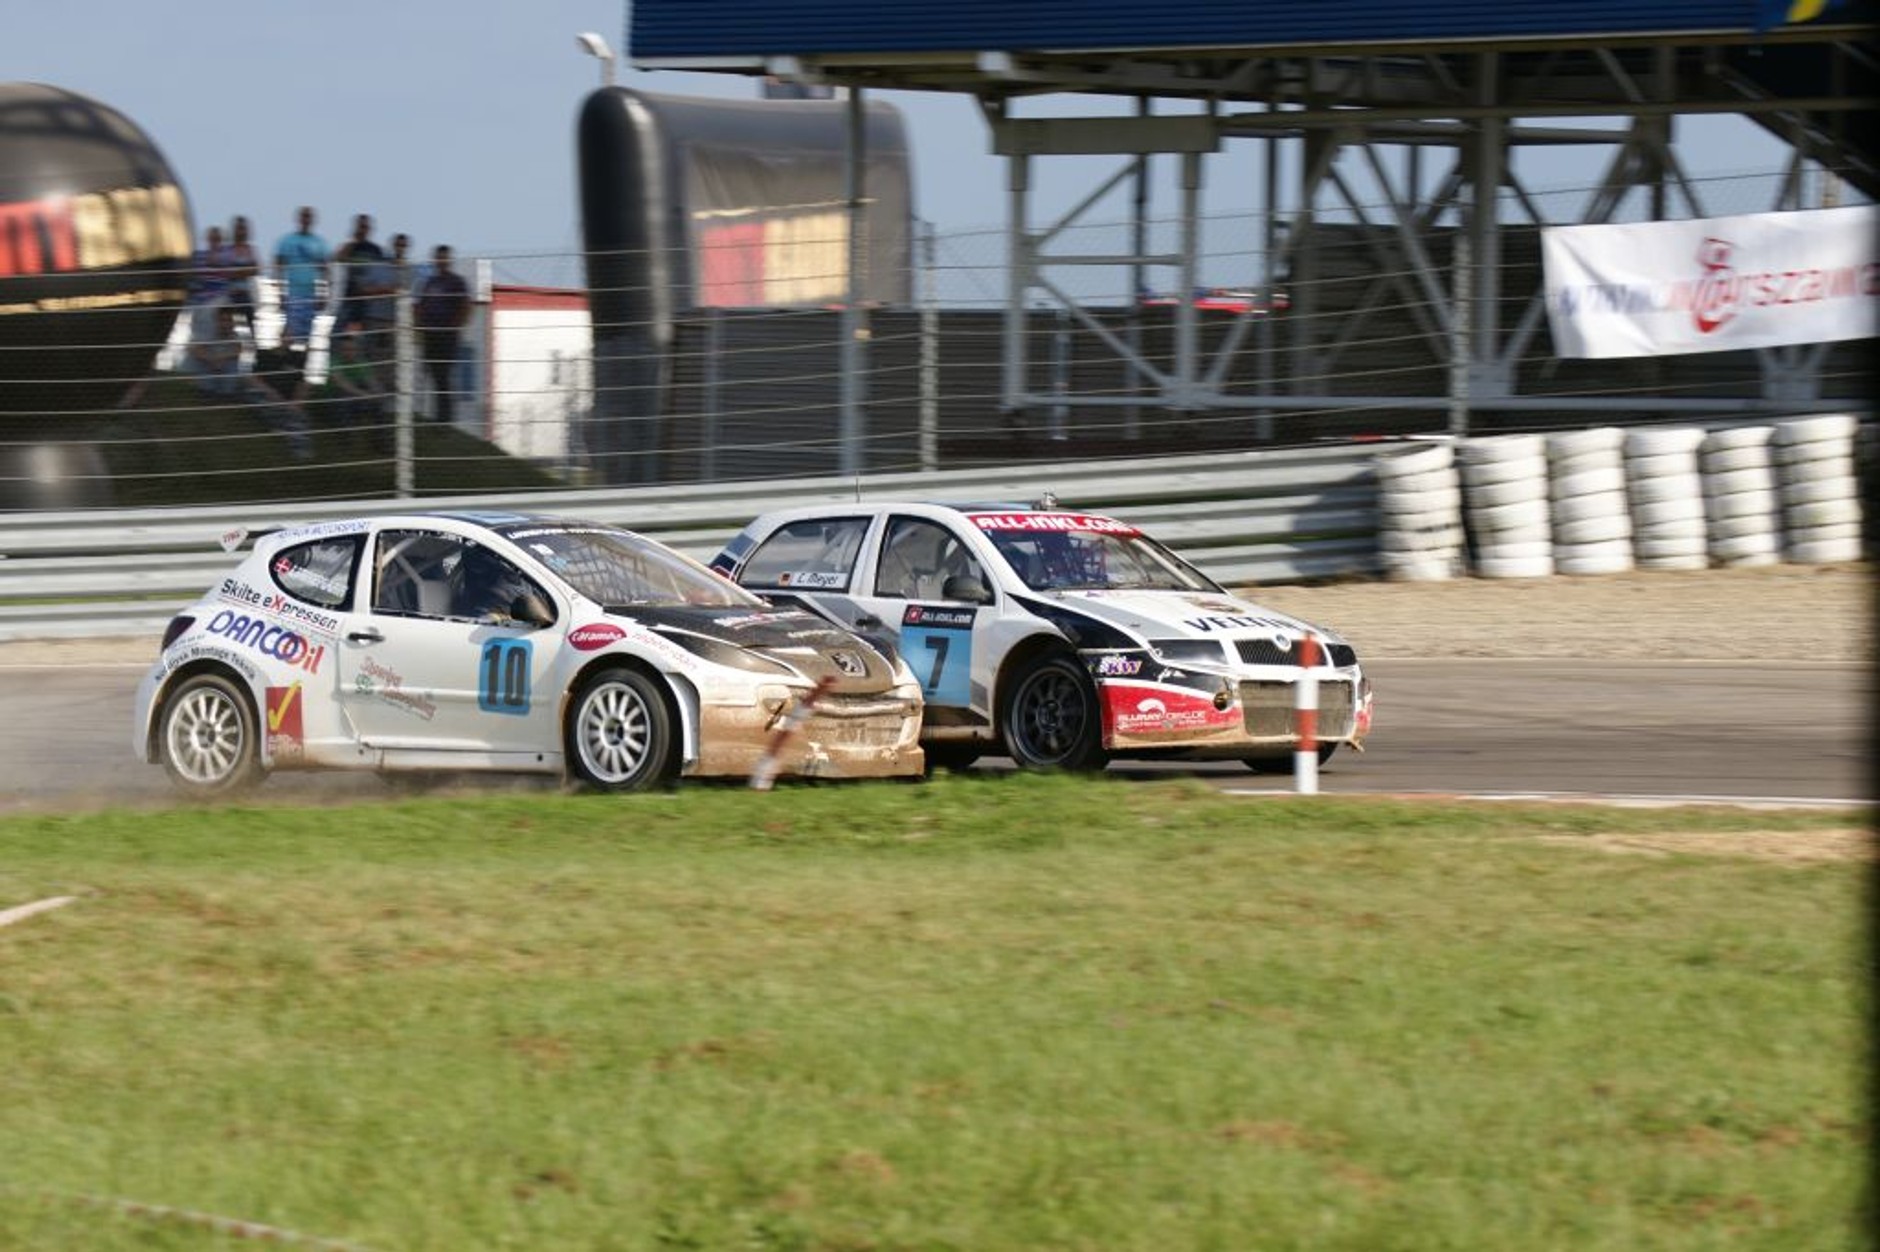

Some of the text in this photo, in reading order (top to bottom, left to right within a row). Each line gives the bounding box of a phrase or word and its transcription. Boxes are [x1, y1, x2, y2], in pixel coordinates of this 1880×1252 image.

[221, 578, 261, 605] Skilte
[807, 572, 839, 587] Meyer
[483, 644, 528, 706] 10
[925, 635, 950, 688] 7
